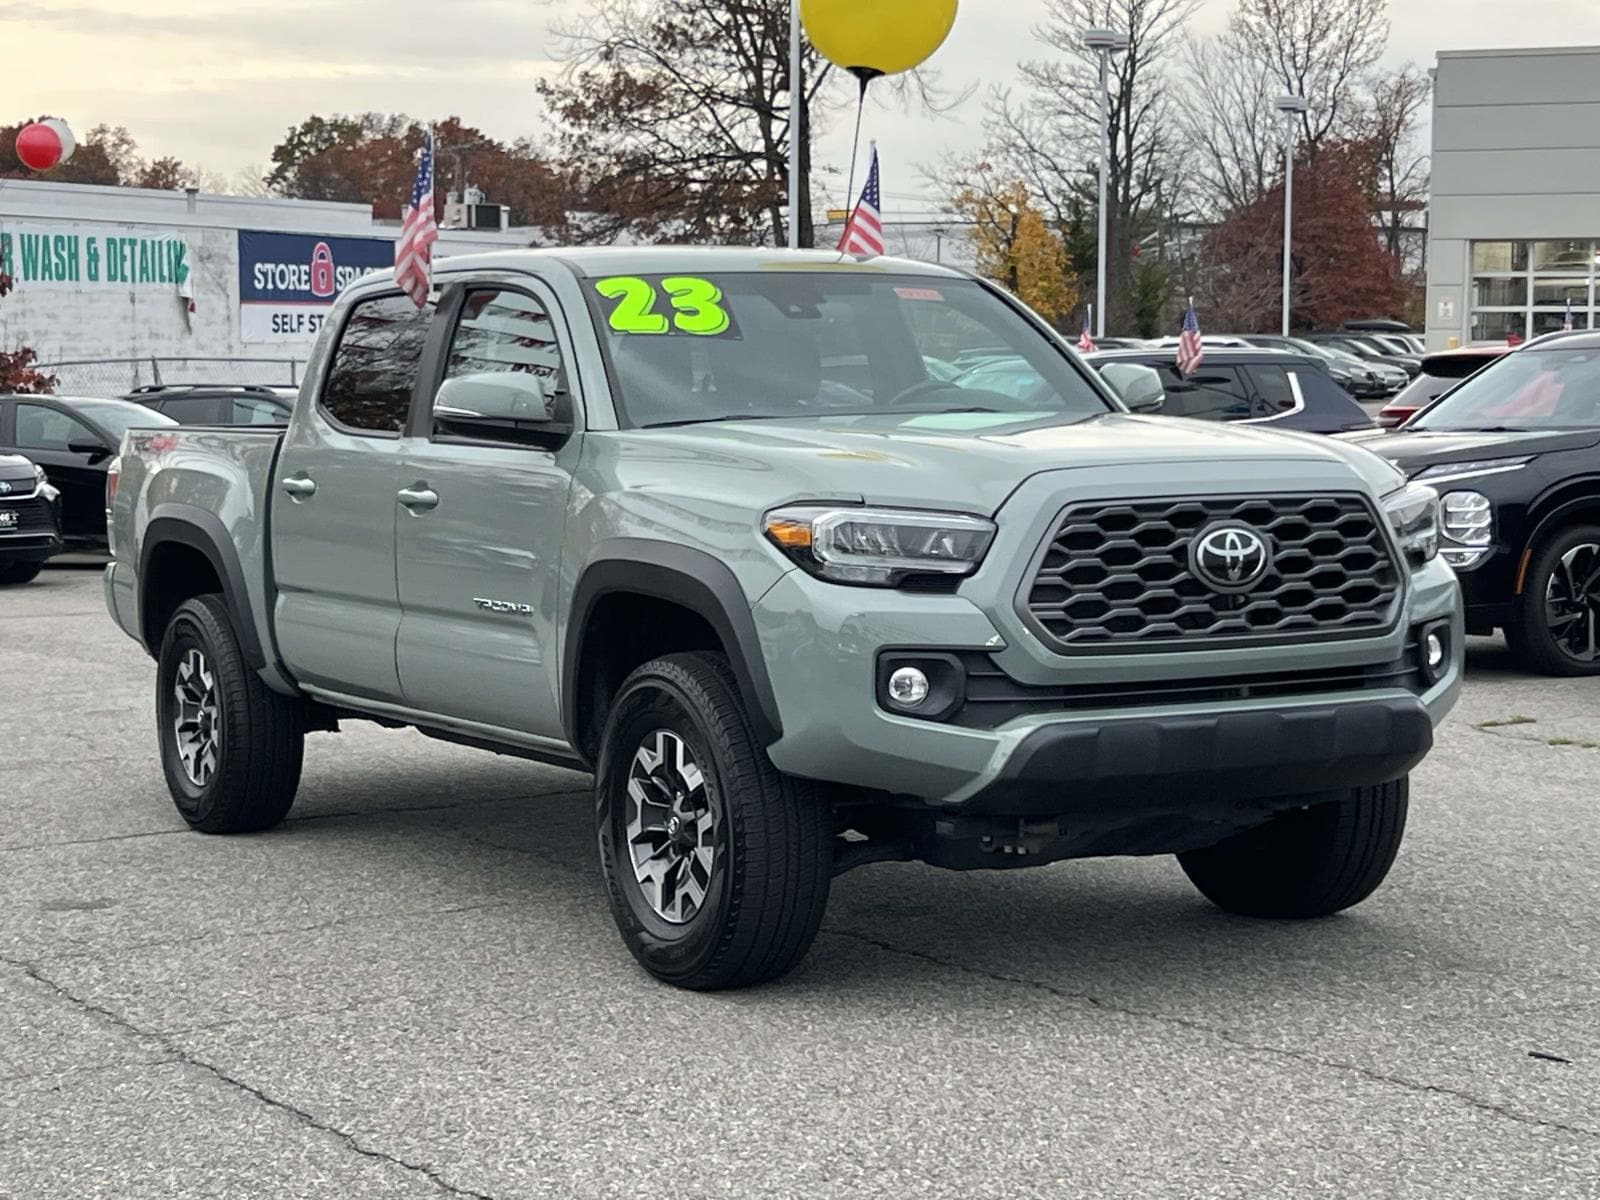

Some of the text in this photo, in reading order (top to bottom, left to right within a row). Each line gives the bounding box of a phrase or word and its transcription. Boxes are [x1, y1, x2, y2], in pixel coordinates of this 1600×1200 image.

[20, 233, 80, 282] WASH
[87, 236, 100, 282] &
[254, 262, 381, 291] STORE SPA
[272, 314, 304, 333] SELF
[595, 276, 730, 335] 23
